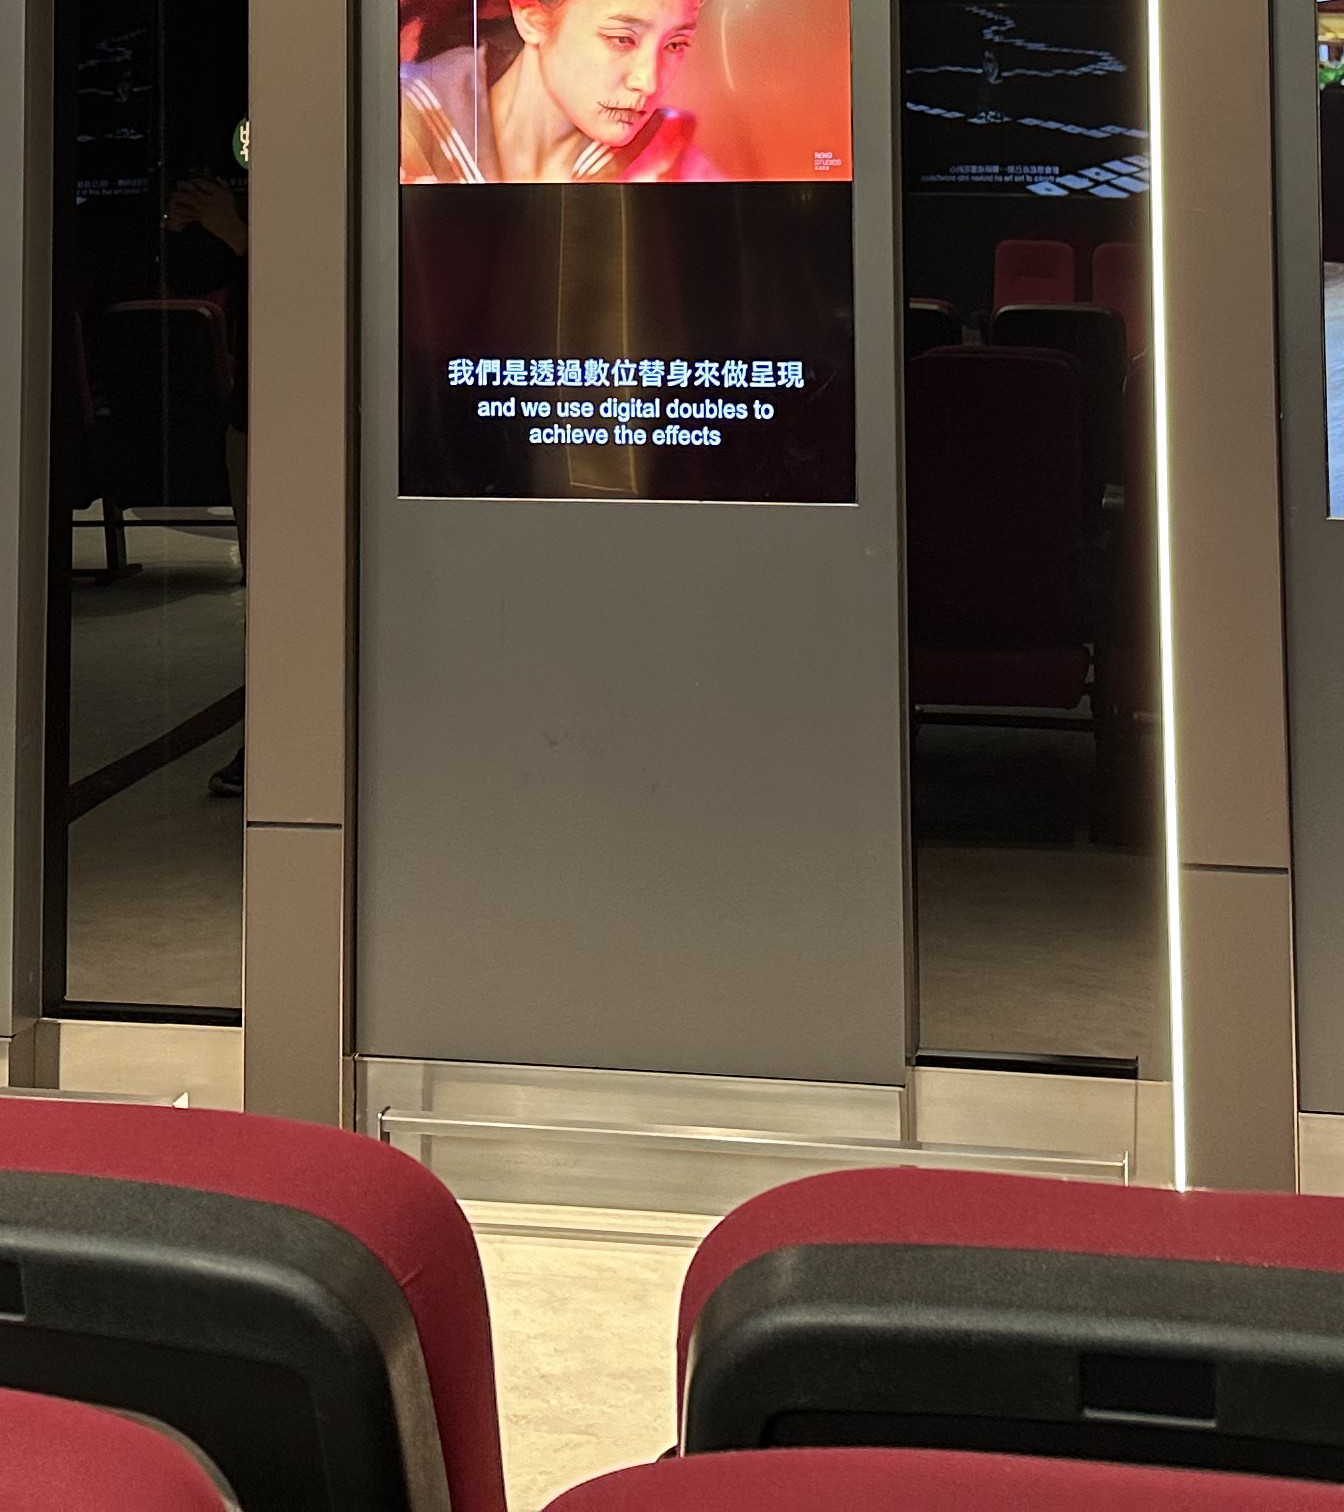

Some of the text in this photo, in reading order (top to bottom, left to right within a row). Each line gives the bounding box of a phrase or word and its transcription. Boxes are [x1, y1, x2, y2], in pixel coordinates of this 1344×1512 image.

[448, 359, 805, 388] 我們是透過數位替身來做呈現
[477, 397, 774, 422] and we use digital doubles to
[529, 425, 721, 445] achieve the effects
